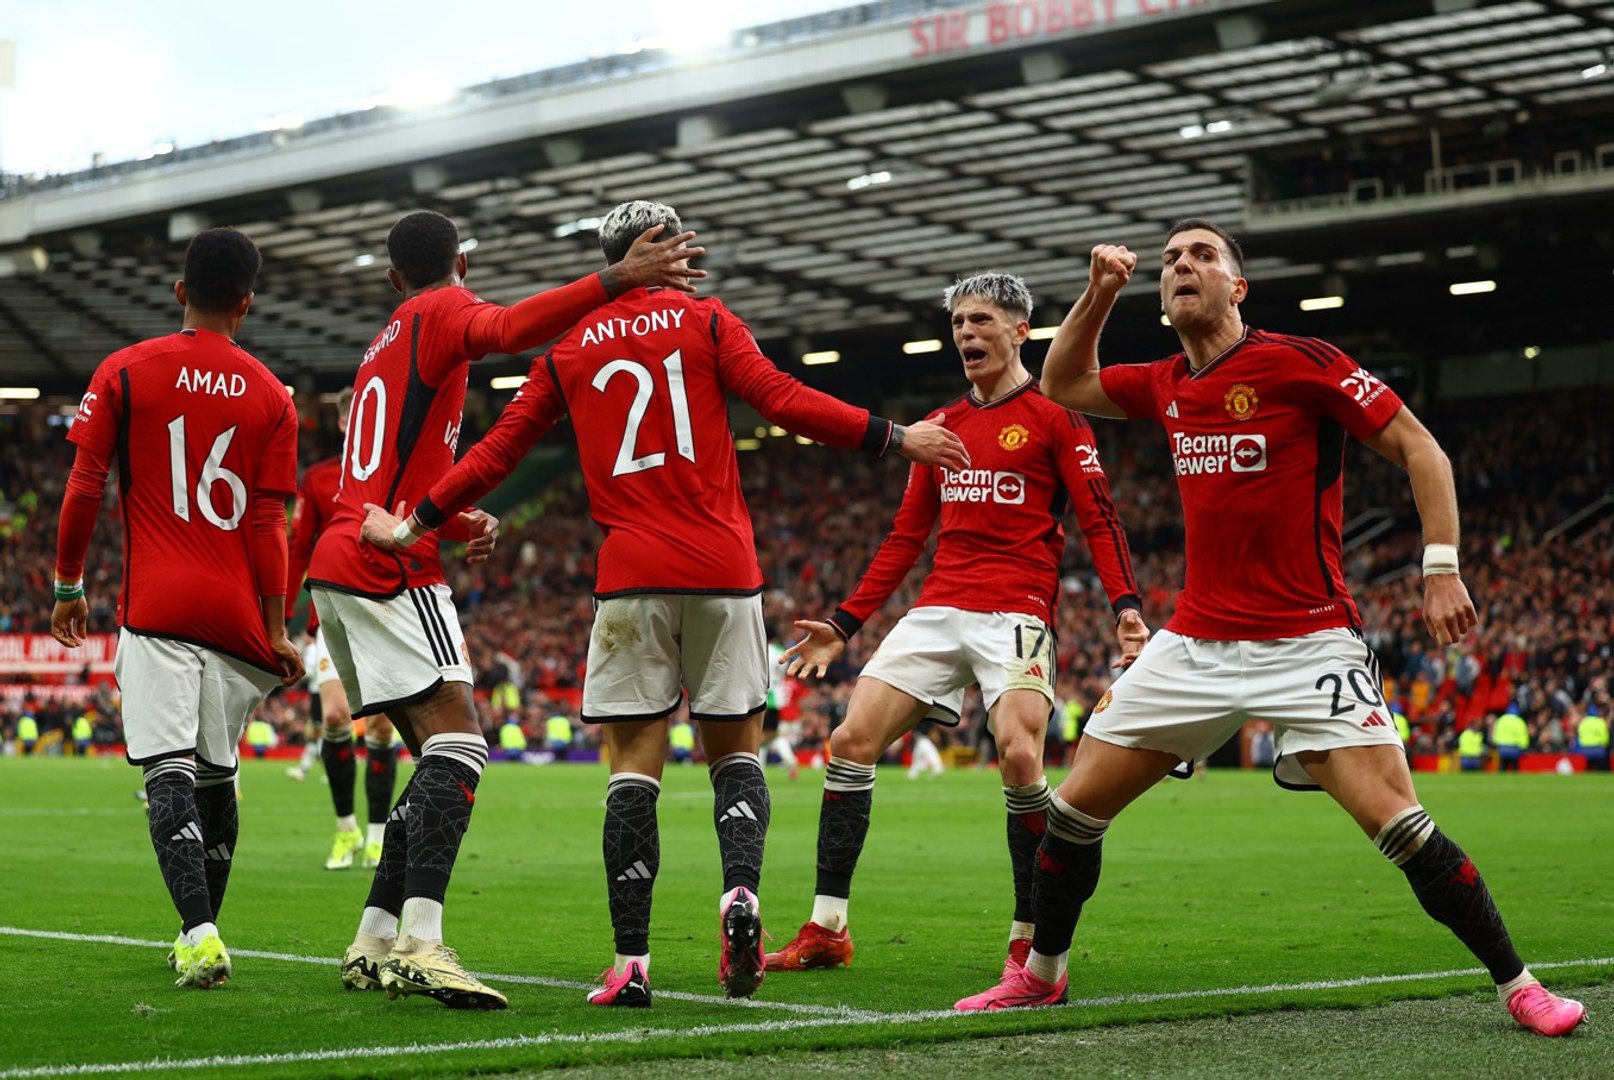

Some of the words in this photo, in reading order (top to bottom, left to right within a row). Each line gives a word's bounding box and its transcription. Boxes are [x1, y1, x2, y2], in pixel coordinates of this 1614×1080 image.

[909, 12, 970, 58] SIR
[581, 308, 685, 348] ANTONY
[175, 366, 247, 399] AMAD
[591, 348, 696, 477] 21
[1172, 432, 1228, 455] Team
[167, 414, 247, 531] 16
[940, 466, 992, 486] Team
[1172, 453, 1228, 477] iewer
[940, 483, 992, 503] iewer
[1014, 623, 1047, 660] 17
[1315, 668, 1383, 717] 20
